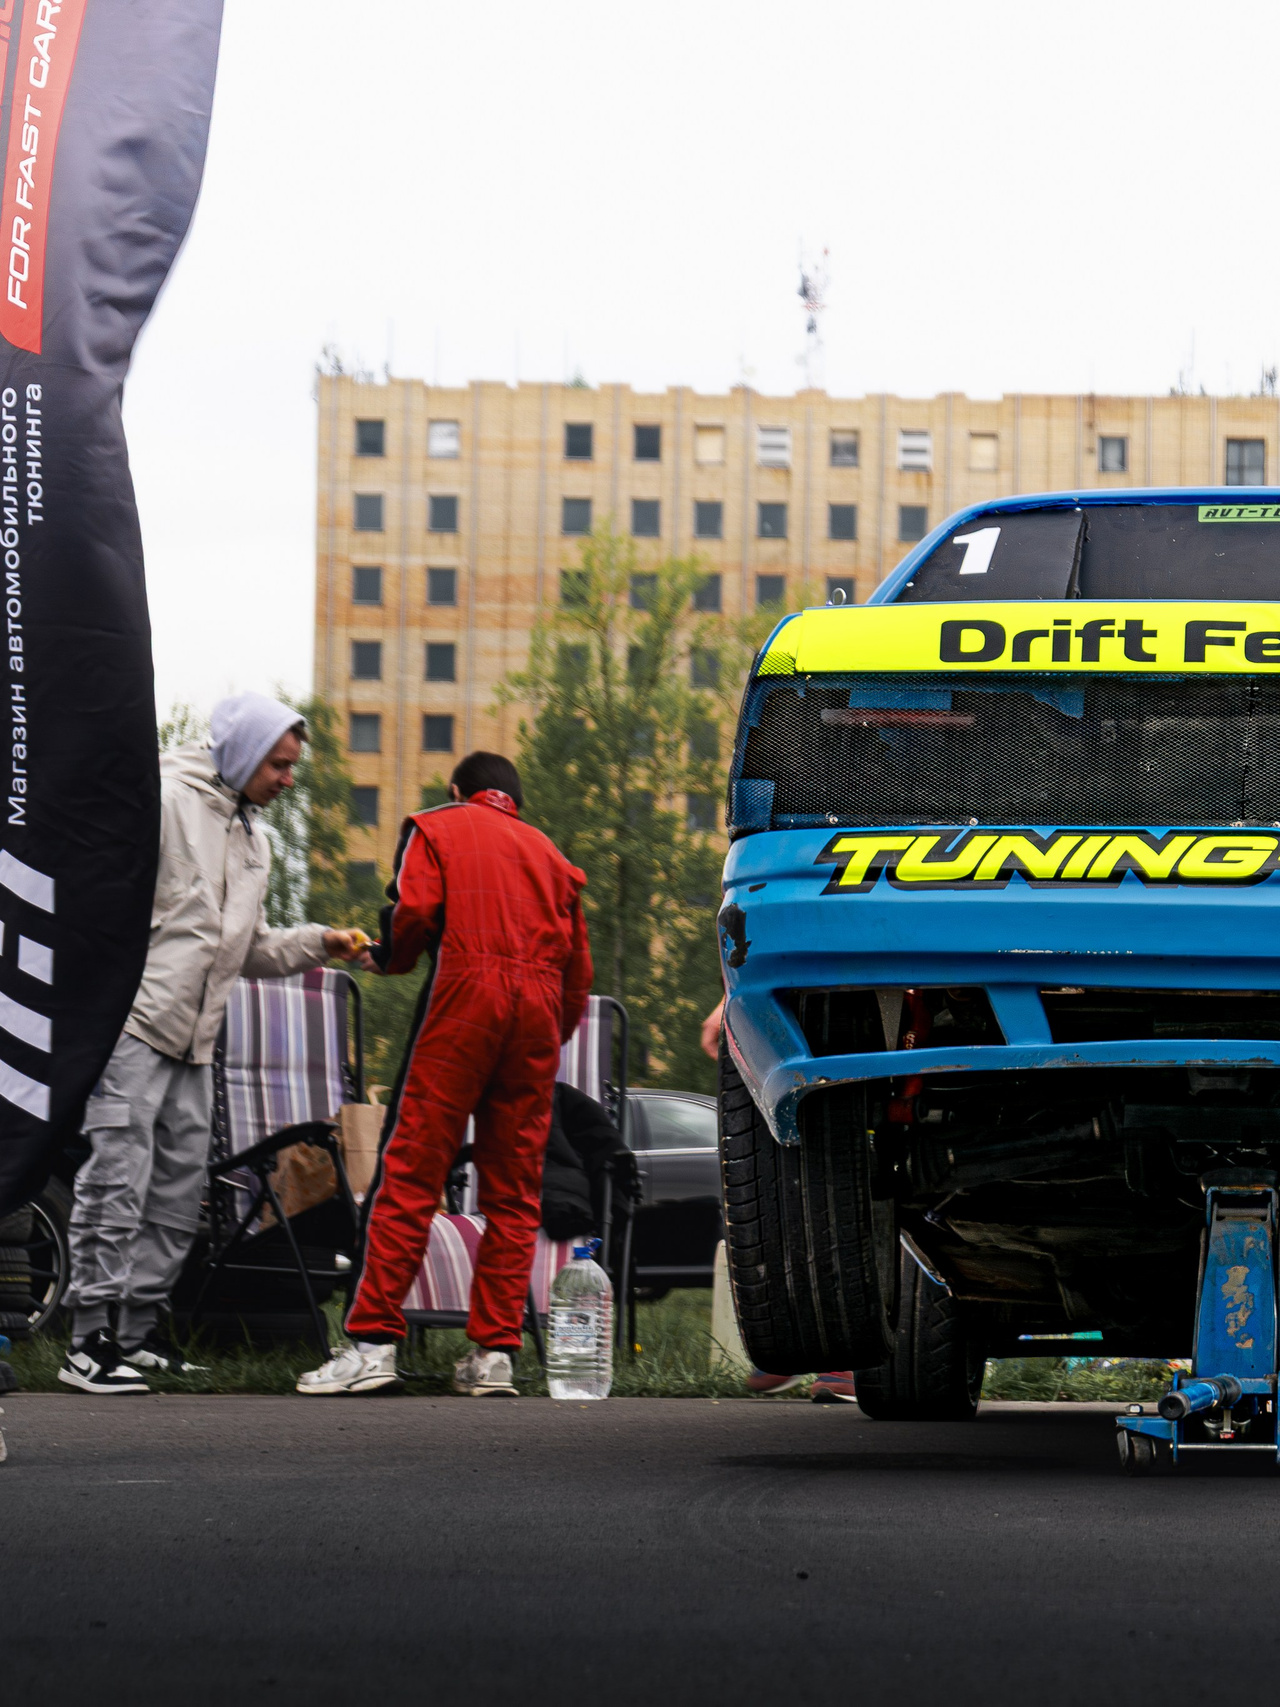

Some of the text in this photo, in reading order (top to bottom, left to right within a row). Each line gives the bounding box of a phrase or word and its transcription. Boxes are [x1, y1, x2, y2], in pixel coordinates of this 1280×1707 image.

[7, 0, 63, 309] FOR FAST CAR
[25, 383, 45, 526] тюнинга
[0, 387, 27, 827] Магазин автомобильного
[953, 526, 1001, 575] 1
[939, 618, 1158, 663] Drift
